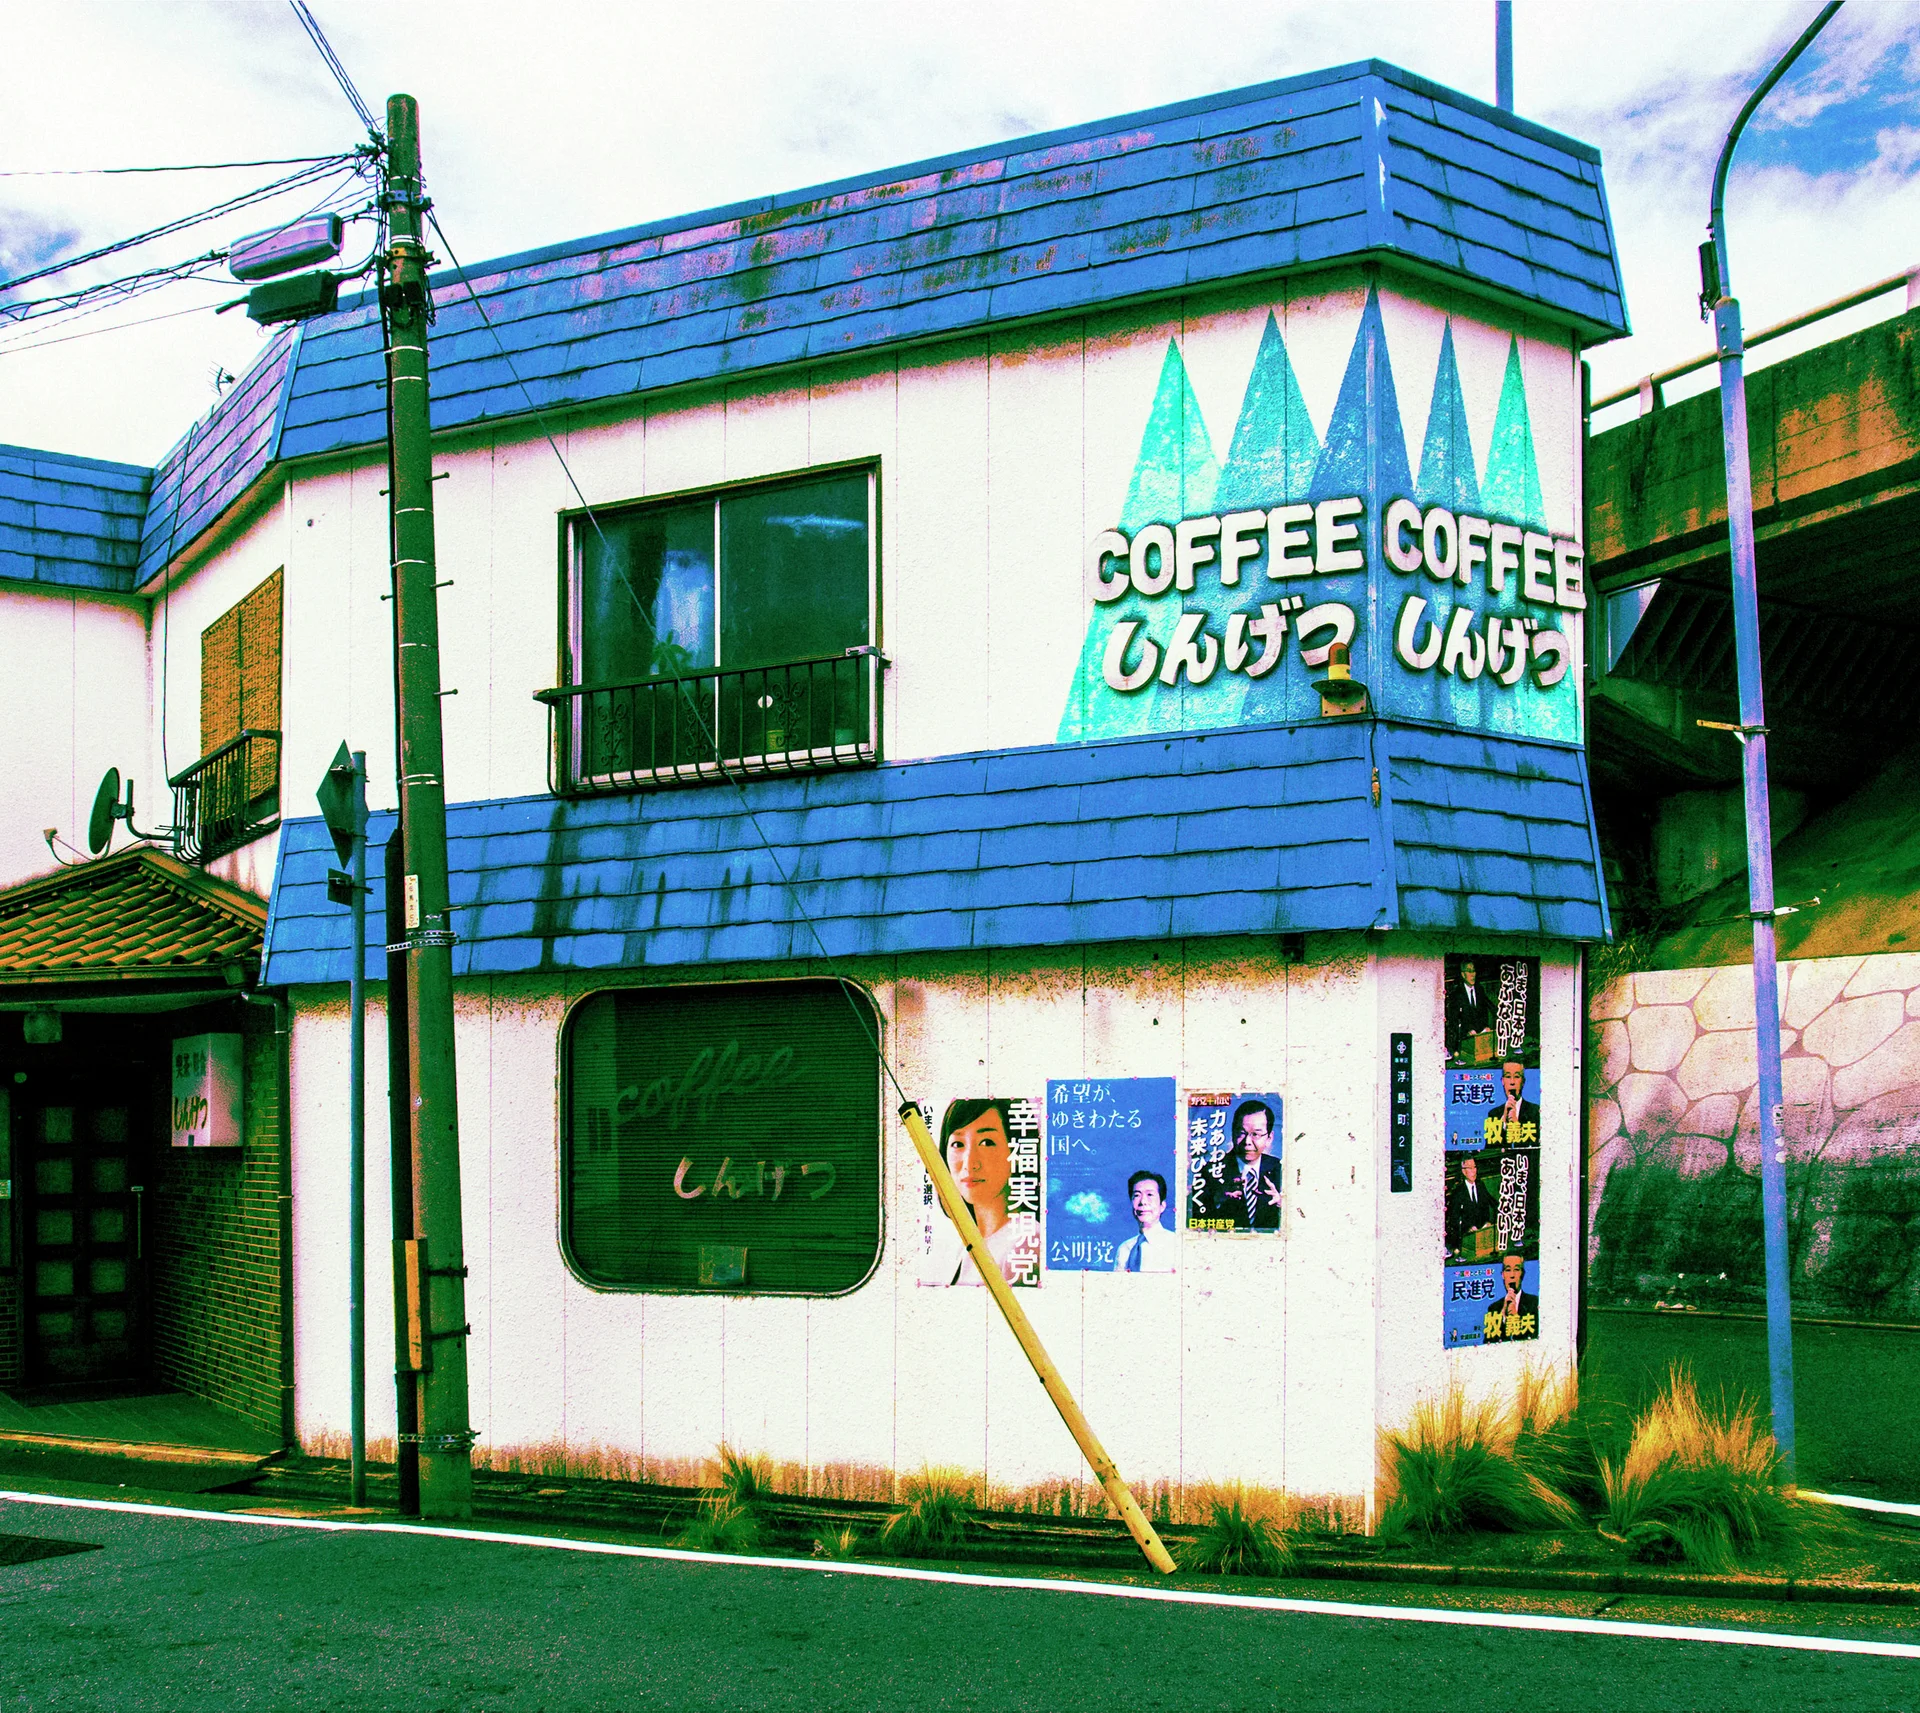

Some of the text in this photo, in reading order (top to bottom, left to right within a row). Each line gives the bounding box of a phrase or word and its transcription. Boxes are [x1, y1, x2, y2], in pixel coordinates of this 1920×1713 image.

[1087, 497, 1365, 602] COFFEE
[1383, 498, 1587, 610] COFFEE
[1101, 595, 1357, 693] しんげつ
[1395, 595, 1571, 688] しんげつ
[1051, 1108, 1142, 1129] ゆきわたる
[1451, 1083, 1496, 1105] 民進党
[1006, 1099, 1040, 1286] 幸福実現党
[1050, 1240, 1115, 1263] 公明党
[1188, 1218, 1235, 1231] 日本共産党
[1450, 1277, 1496, 1303] 民進党
